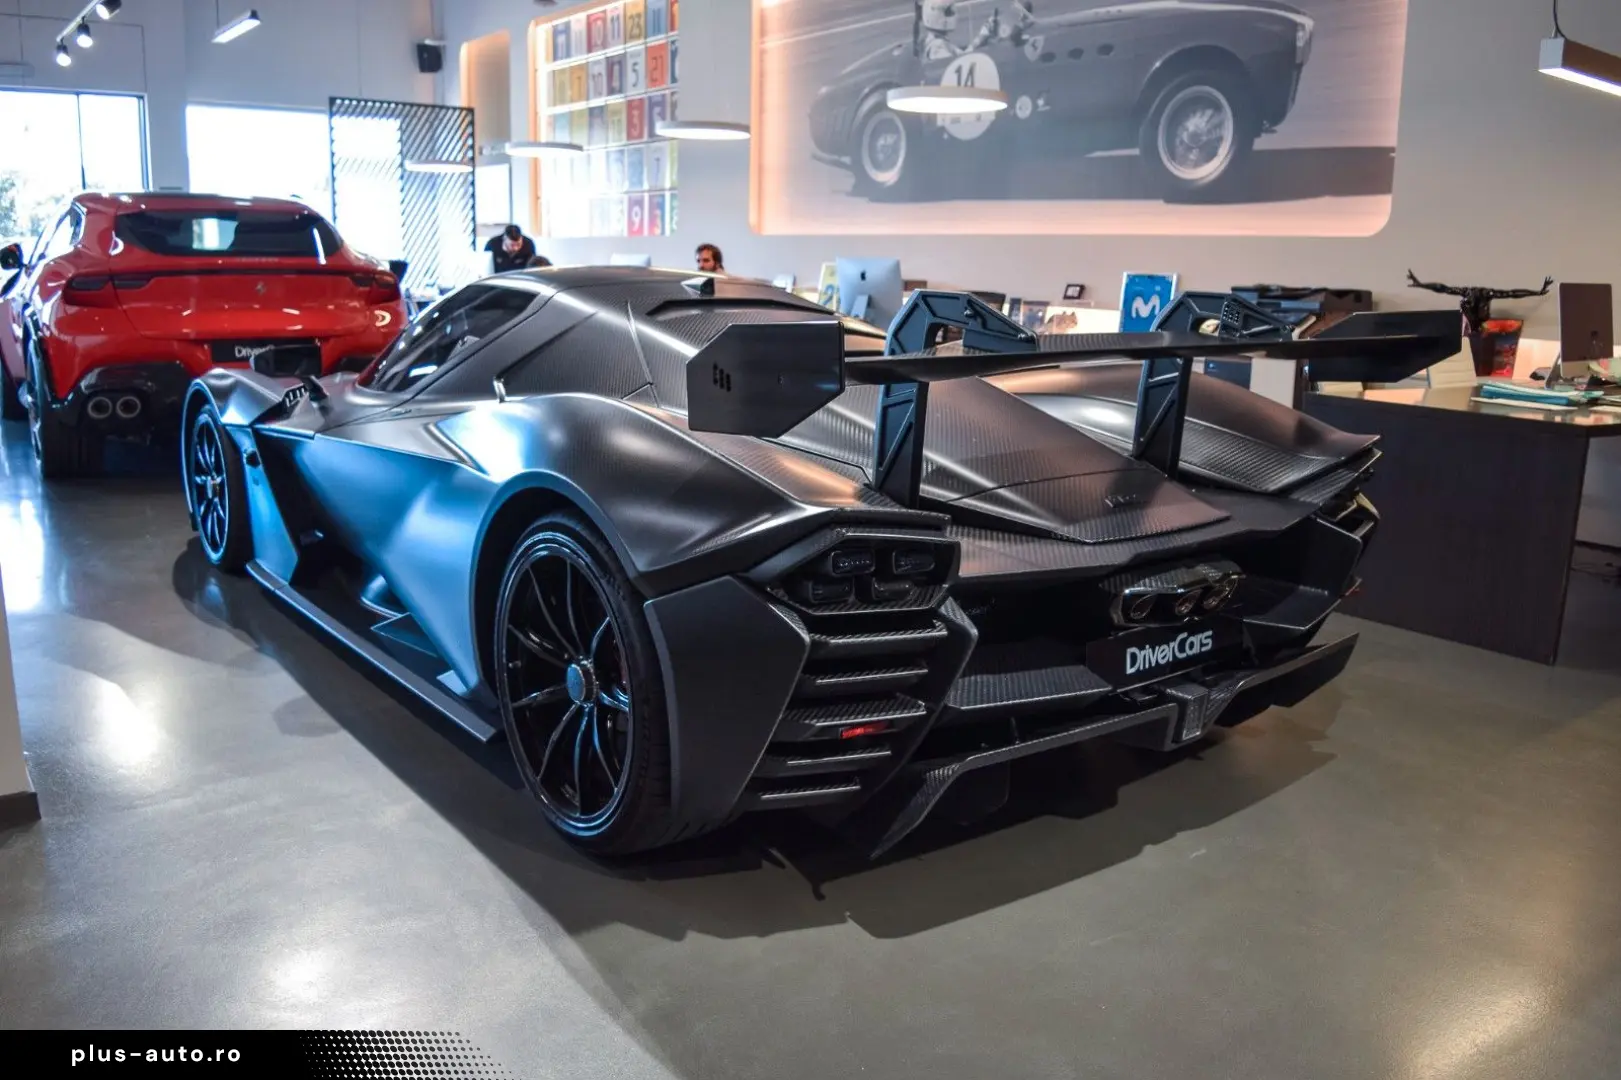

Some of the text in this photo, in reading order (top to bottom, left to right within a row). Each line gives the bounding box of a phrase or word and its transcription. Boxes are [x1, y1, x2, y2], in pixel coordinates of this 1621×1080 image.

[631, 62, 640, 88] 5
[631, 205, 641, 232] 9
[1126, 630, 1213, 675] DriverCars
